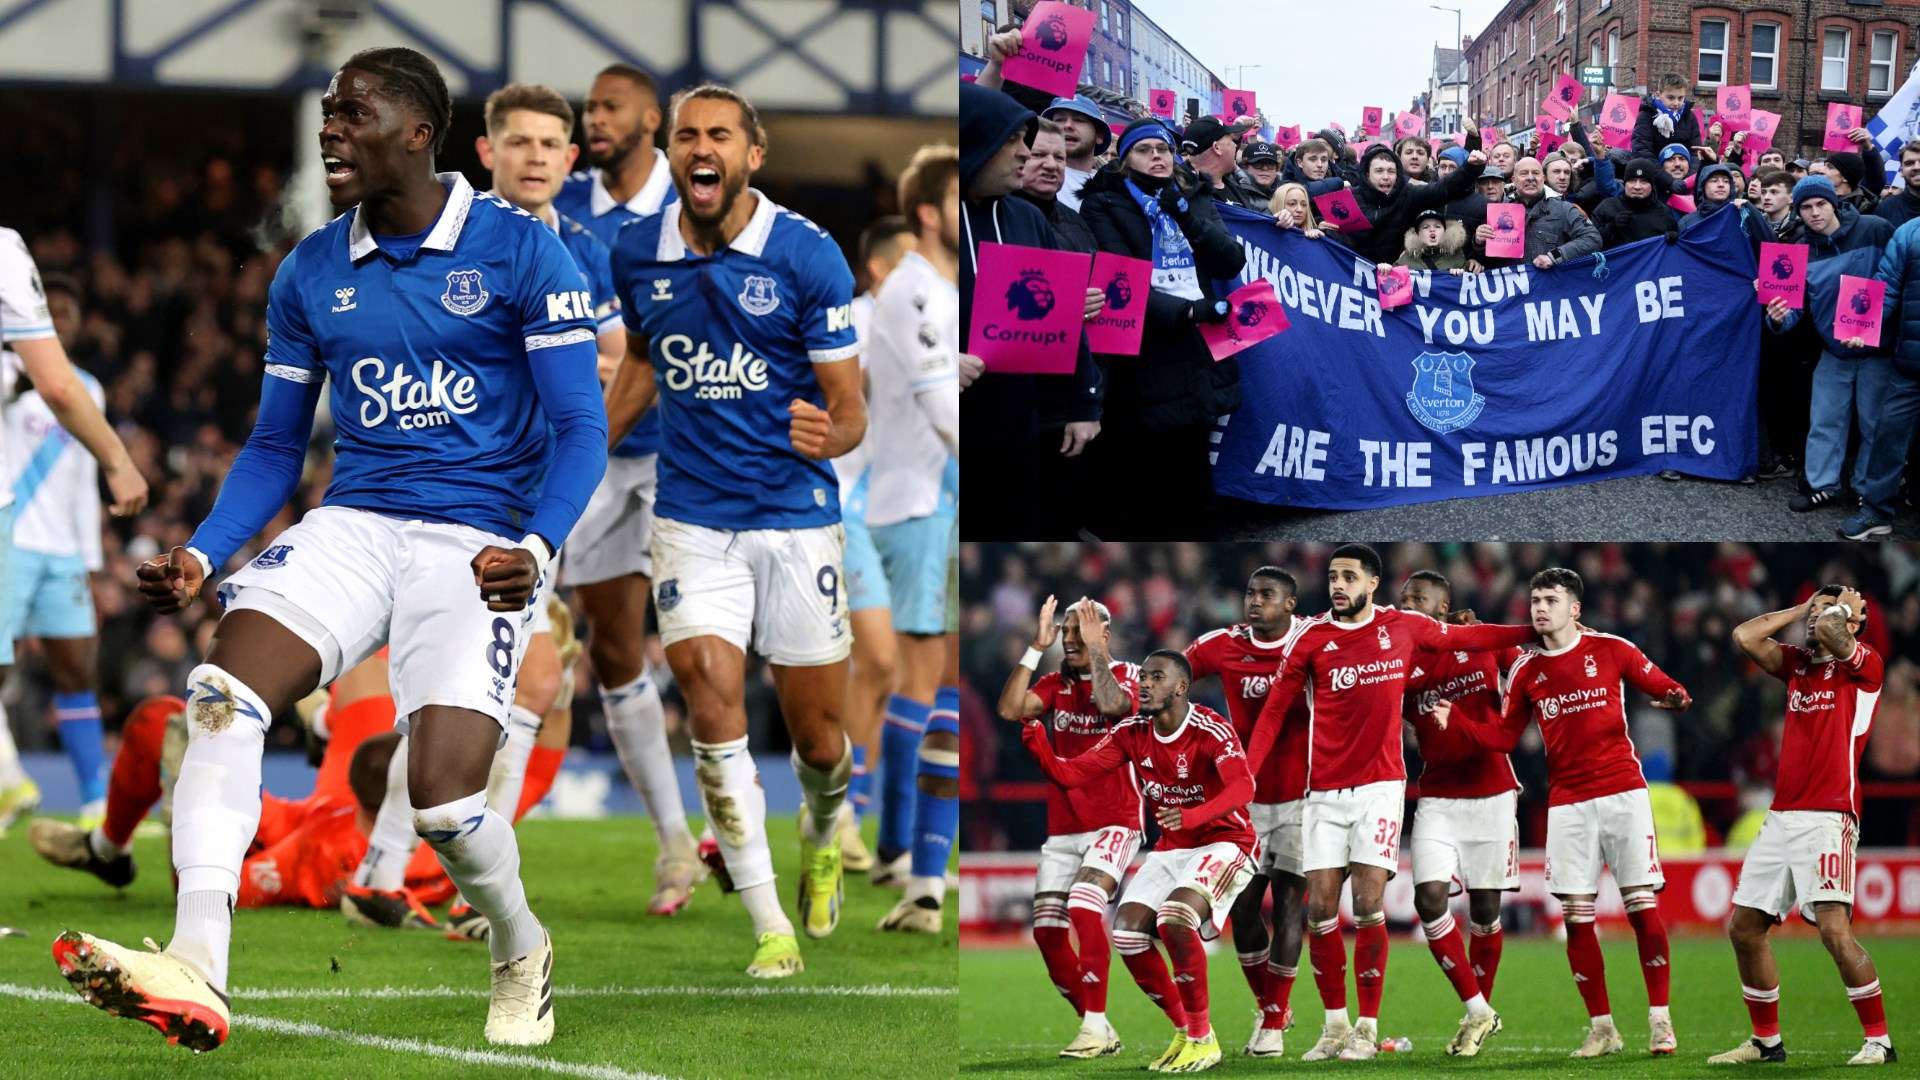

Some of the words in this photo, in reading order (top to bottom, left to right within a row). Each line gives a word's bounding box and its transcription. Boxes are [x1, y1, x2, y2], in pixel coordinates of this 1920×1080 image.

[1018, 45, 1073, 74] Corrupt
[1237, 235, 1386, 338] WHOEVER
[1416, 304, 1495, 345] YOU
[1524, 293, 1605, 342] MAY
[1635, 275, 1684, 323] BE
[1459, 264, 1530, 305] RUN
[1763, 281, 1799, 293] Corrupt
[983, 324, 1067, 345] Corrupt
[1840, 315, 1875, 329] Corrupt
[660, 334, 769, 391] Stake
[351, 357, 478, 428] Stake
[694, 384, 742, 400] .com
[1421, 396, 1465, 408] Everton
[396, 410, 450, 431] .com
[1254, 423, 1331, 482] ARE
[1359, 438, 1432, 488] THE
[1461, 430, 1618, 486] FAMOUS
[1641, 415, 1715, 456] EFC
[816, 564, 838, 616] 9
[486, 616, 515, 679] 8
[1094, 830, 1124, 853] 28
[1374, 817, 1398, 848] 32
[1646, 835, 1655, 861] 7
[1197, 854, 1223, 878] 14
[1818, 852, 1840, 880] 10
